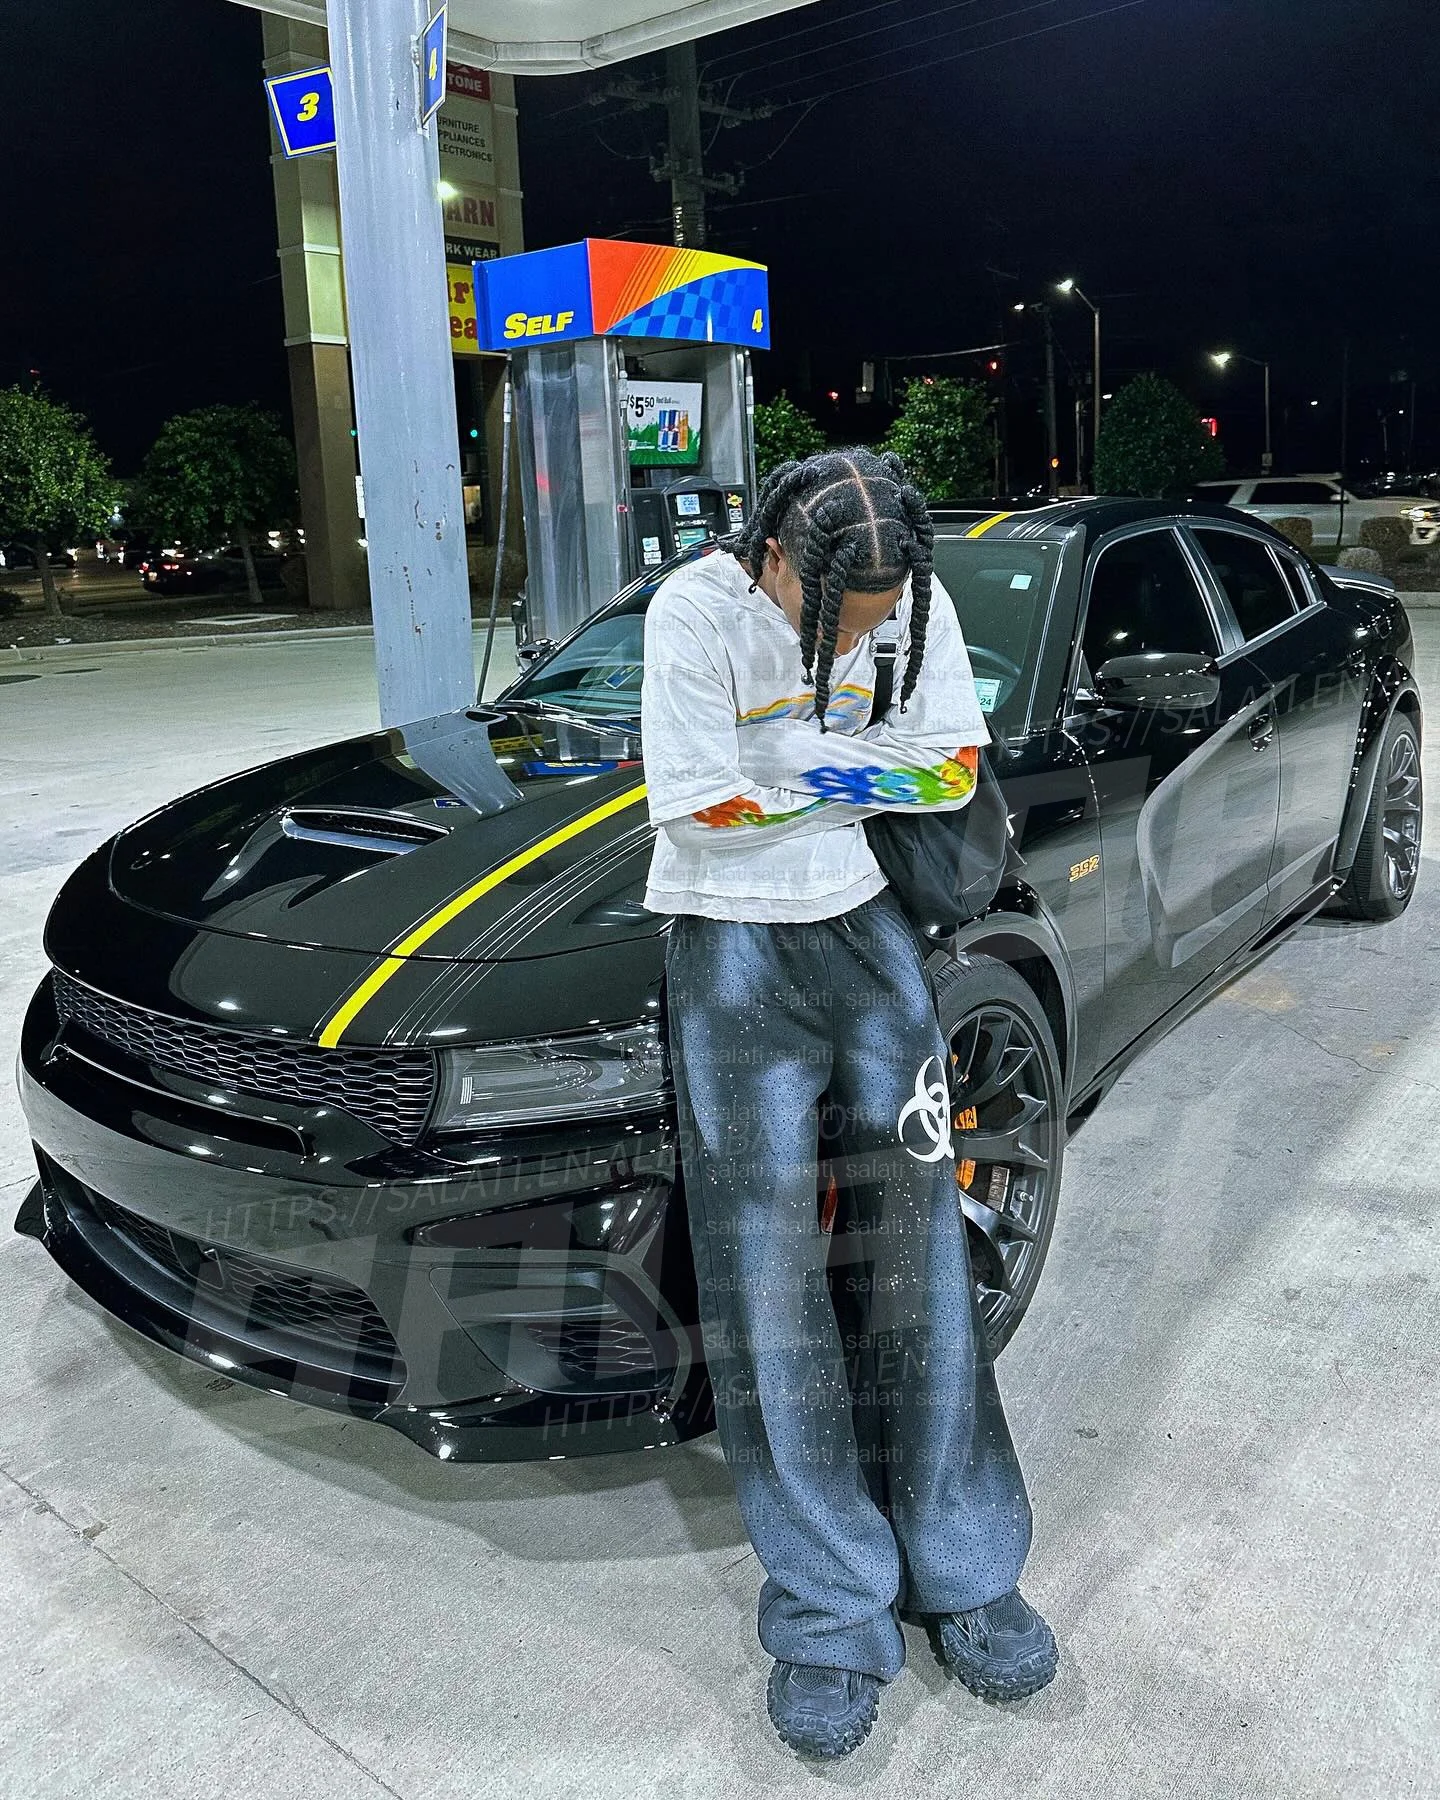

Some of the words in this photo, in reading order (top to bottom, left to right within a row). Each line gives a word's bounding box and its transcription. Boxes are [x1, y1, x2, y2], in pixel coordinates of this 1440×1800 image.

[297, 93, 320, 122] 3
[464, 245, 498, 259] WEAR
[752, 309, 764, 334] 4
[1069, 854, 1100, 883] 392
